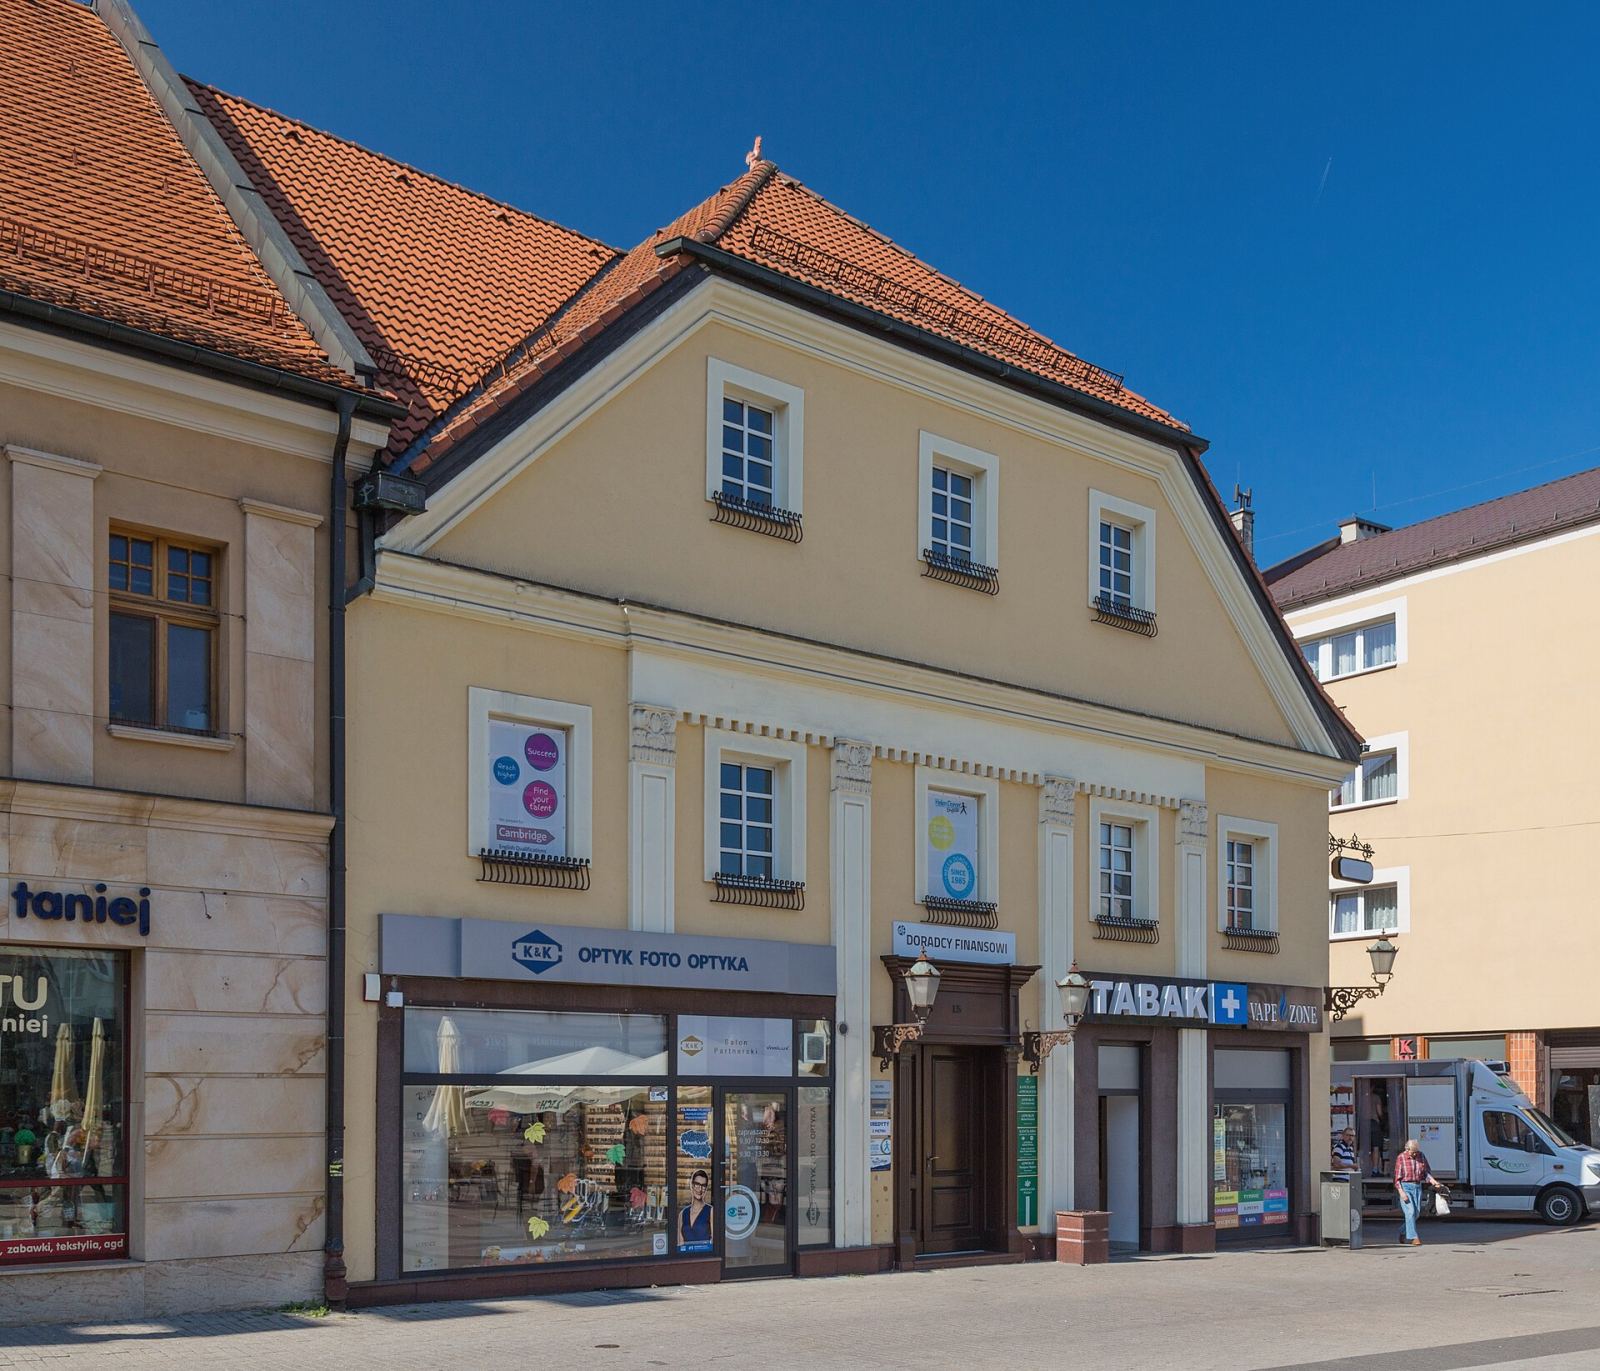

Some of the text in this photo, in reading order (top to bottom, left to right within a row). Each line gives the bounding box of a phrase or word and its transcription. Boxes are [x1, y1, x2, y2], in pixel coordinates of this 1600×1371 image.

[527, 747, 556, 758] Succeed
[533, 787, 549, 795] Find
[529, 803, 552, 812] talent
[533, 796, 549, 804] your
[499, 827, 547, 843] Cambridge
[11, 881, 151, 936] taniej
[906, 934, 1008, 954] DORADCY FINANSOWI
[523, 944, 749, 972] K&K OPTYK FOTO OPTYKA
[1091, 980, 1209, 1019] TABAK
[1250, 1001, 1318, 1024] VAPE ZONE
[7, 1238, 124, 1254] zabawki, tekstylia, agd
